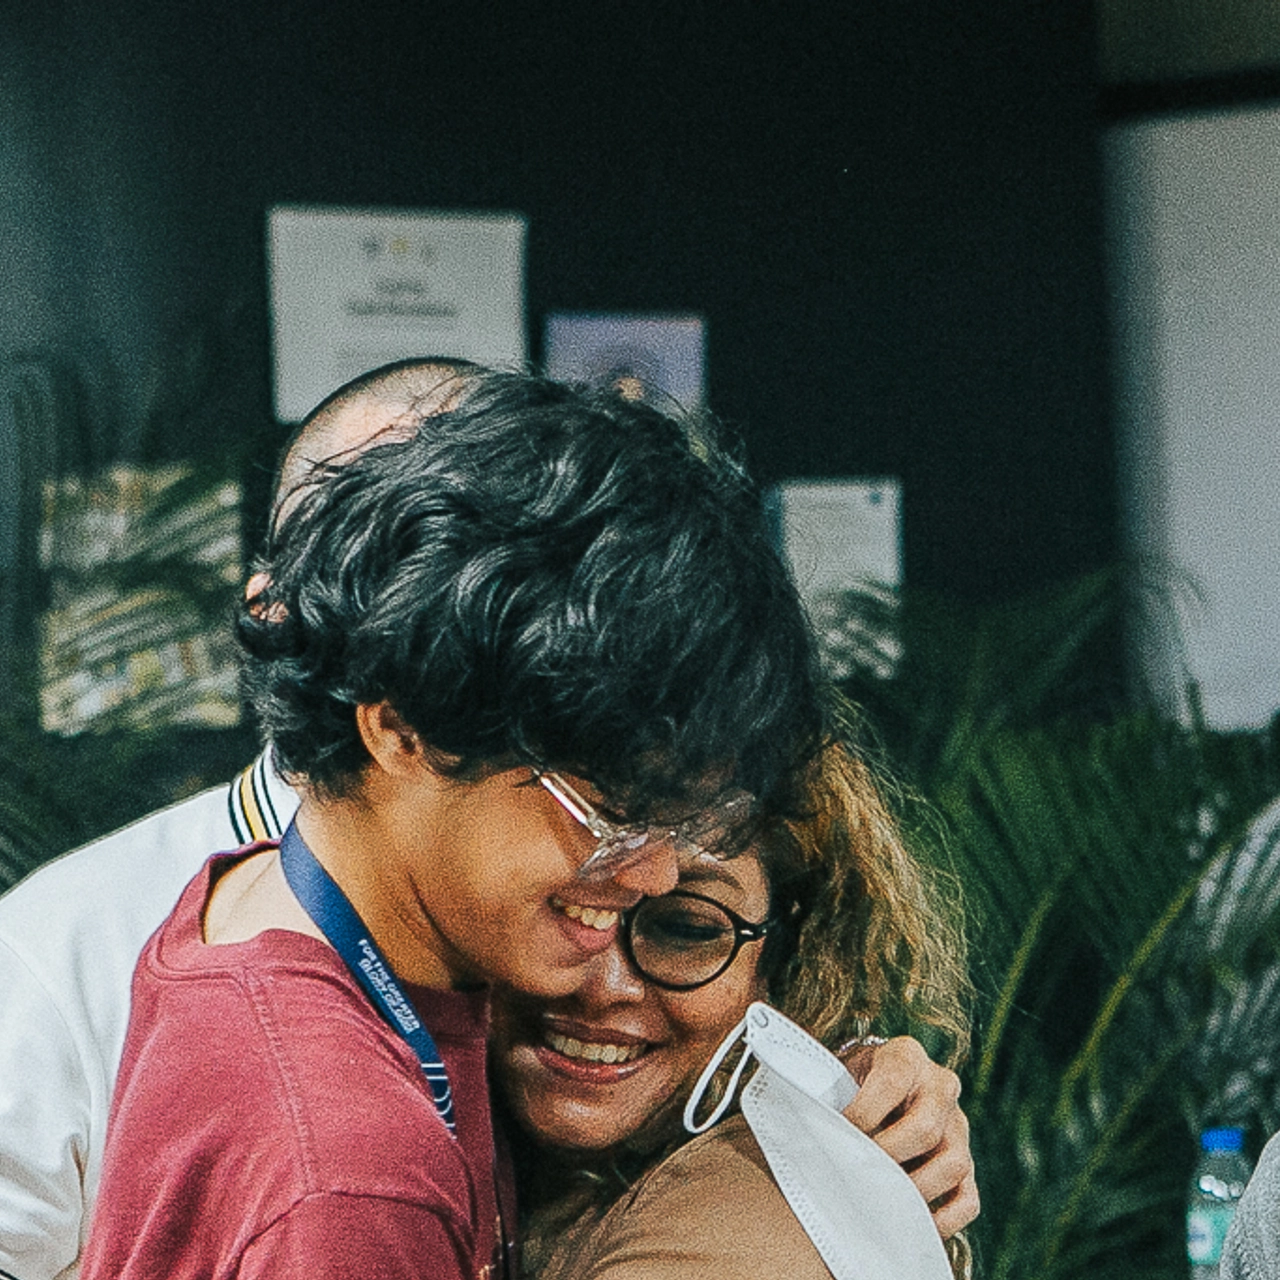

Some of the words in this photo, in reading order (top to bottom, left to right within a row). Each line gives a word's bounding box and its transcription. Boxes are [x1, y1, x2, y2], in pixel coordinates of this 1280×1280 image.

[358, 938, 378, 961] FOR
[374, 961, 390, 982] THE
[387, 982, 421, 1030] GREATER
[359, 958, 387, 992] GLORY
